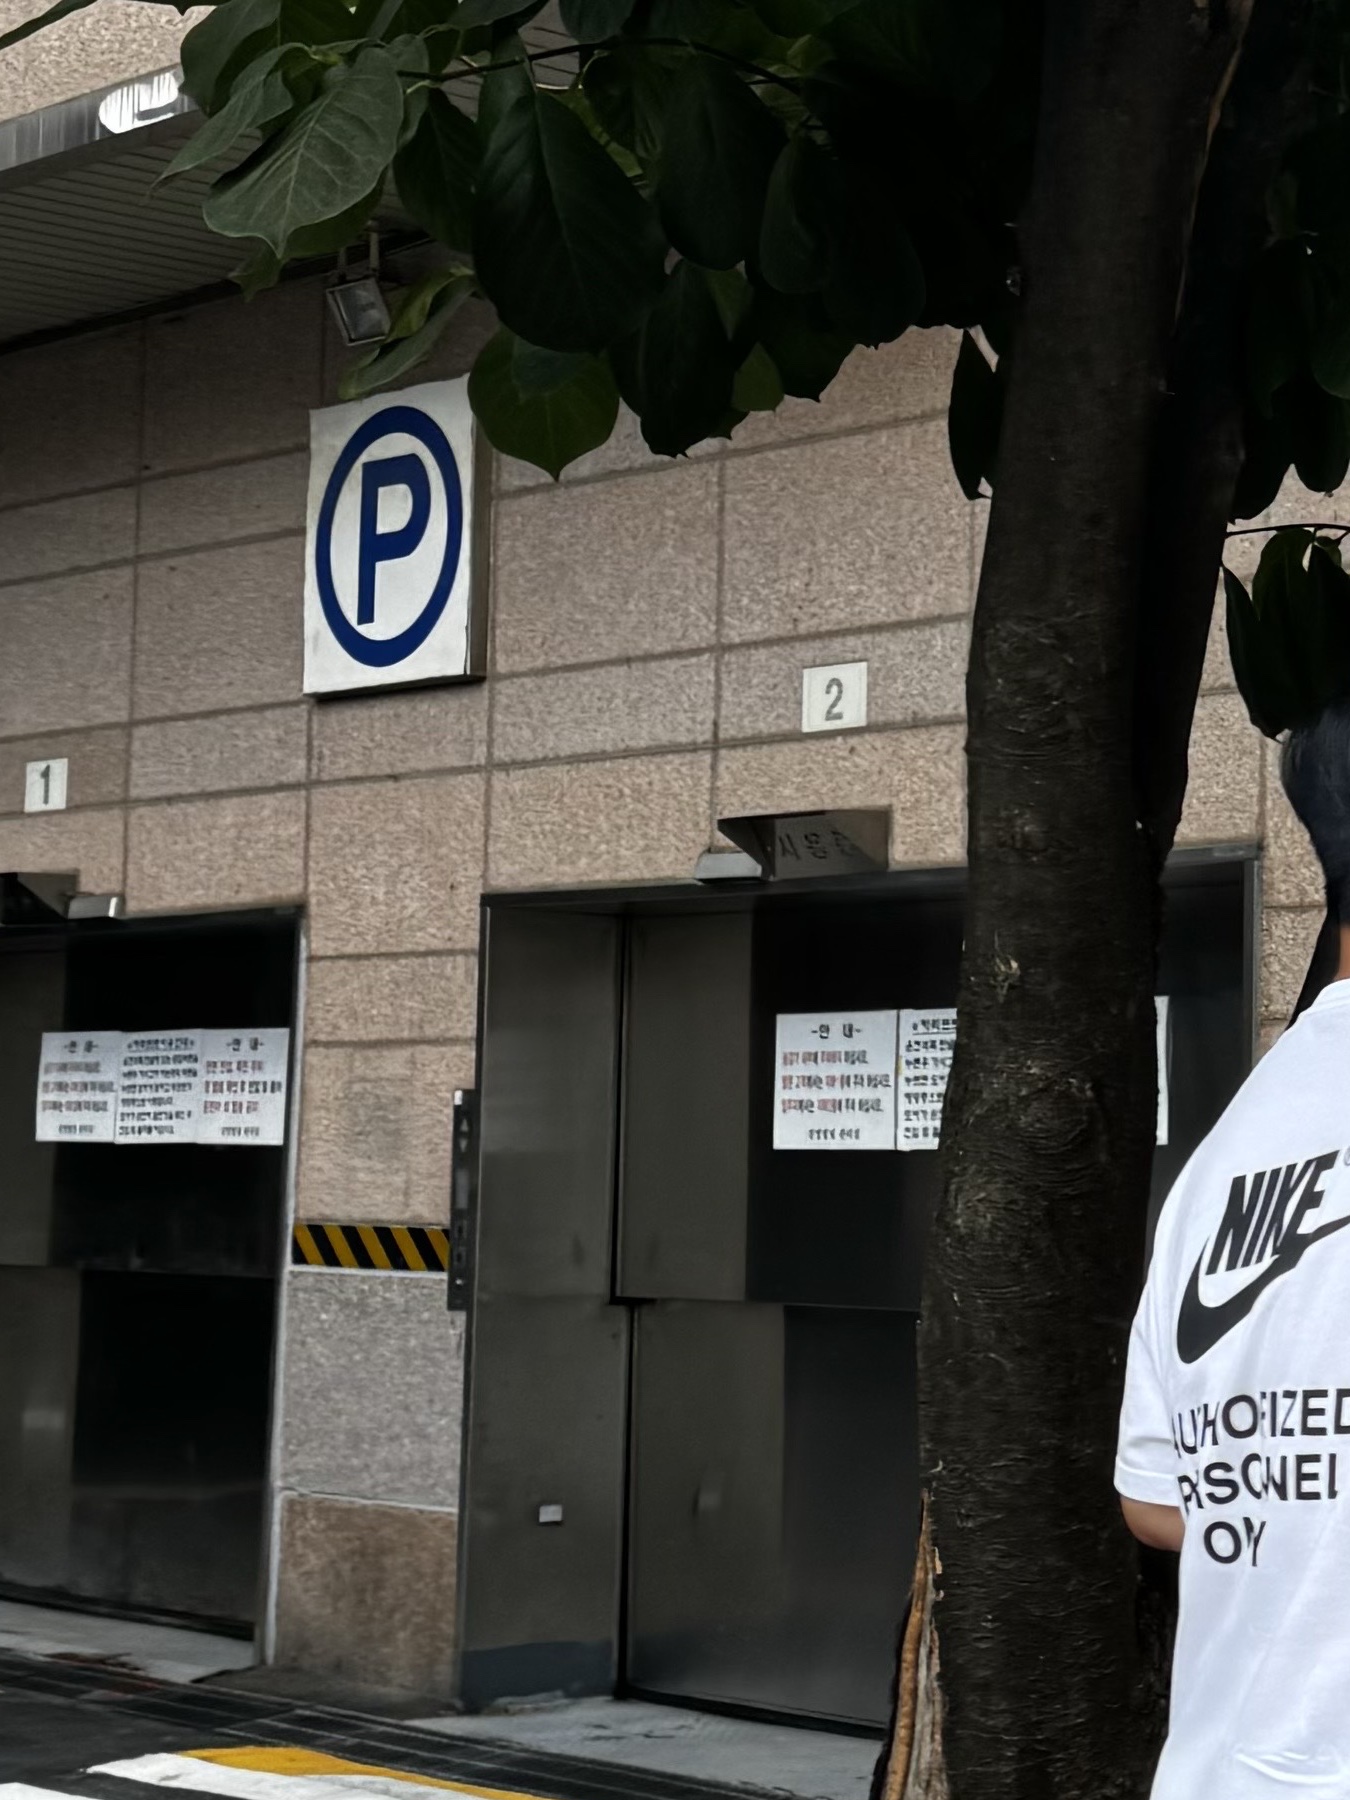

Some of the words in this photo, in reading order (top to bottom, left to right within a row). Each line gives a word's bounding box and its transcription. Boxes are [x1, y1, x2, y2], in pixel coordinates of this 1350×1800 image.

[357, 452, 433, 626] P
[824, 677, 844, 721] 2
[40, 764, 51, 806] 1
